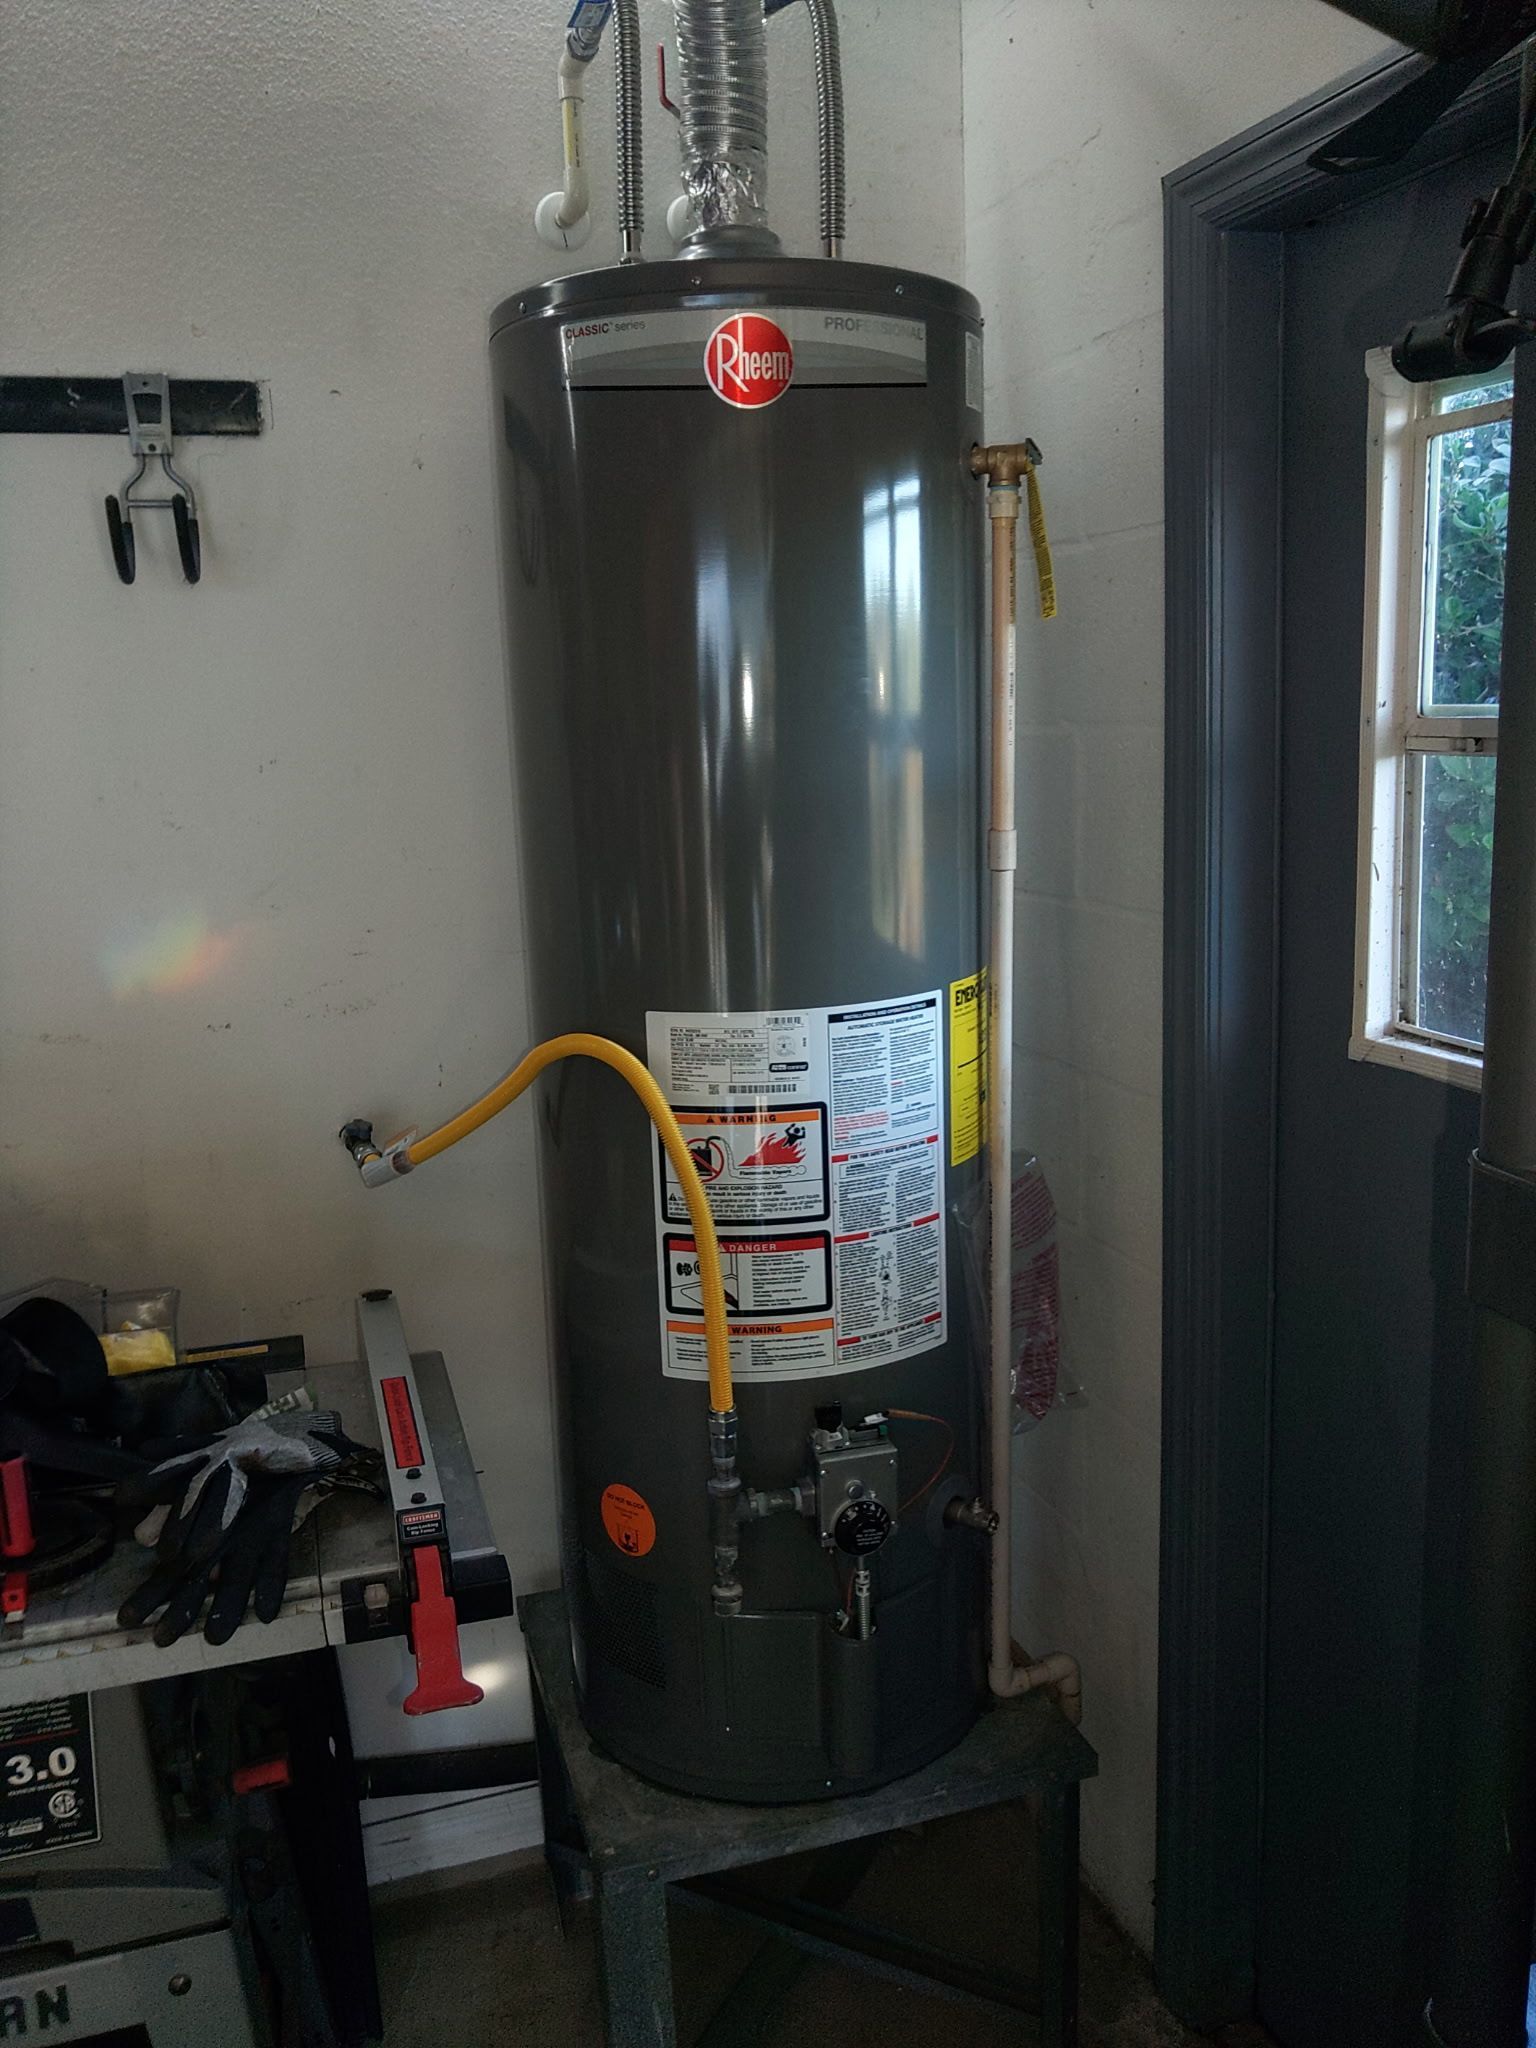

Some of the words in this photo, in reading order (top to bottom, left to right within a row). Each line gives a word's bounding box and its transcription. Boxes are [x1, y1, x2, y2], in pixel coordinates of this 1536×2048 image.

[565, 322, 610, 339] CLASSIC
[614, 319, 647, 332] series
[716, 317, 789, 393] Rheem
[729, 1243, 777, 1253] DANGER
[731, 1325, 782, 1335] WARNING
[5, 1746, 77, 1786] 3.0
